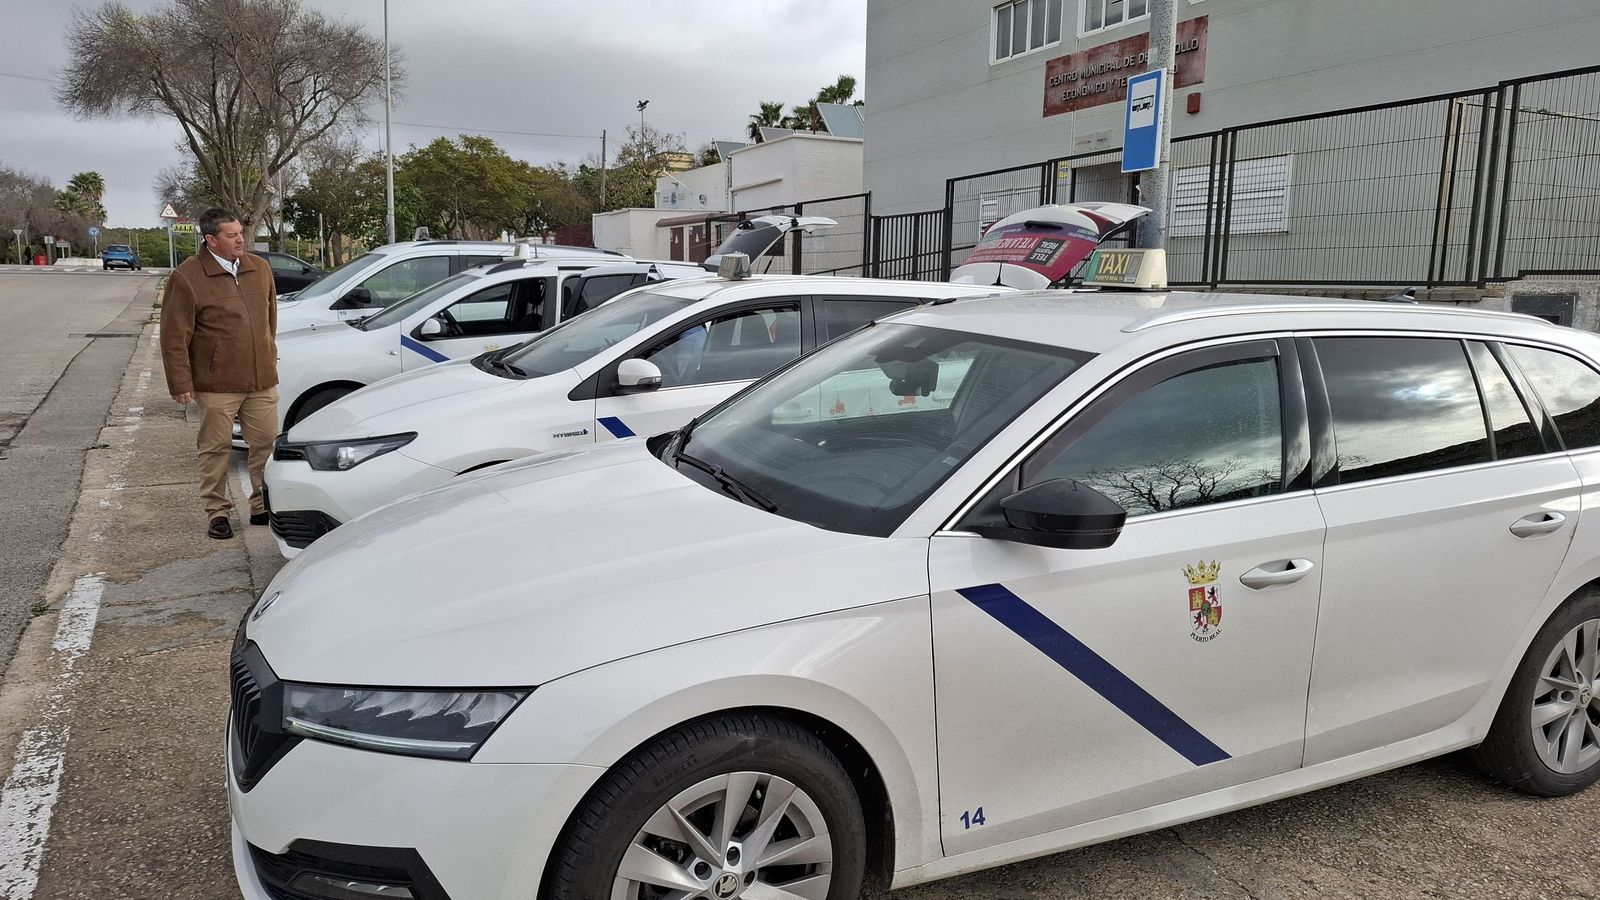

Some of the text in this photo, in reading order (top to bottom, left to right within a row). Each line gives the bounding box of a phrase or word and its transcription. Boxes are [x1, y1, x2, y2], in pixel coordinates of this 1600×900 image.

[1049, 71, 1078, 87] CENTRO
[1081, 59, 1122, 79] MUNICIPAL
[1123, 55, 1135, 68] DE
[1062, 81, 1107, 101] ECONÓMICO
[1029, 252, 1049, 261] TELE
[1098, 253, 1130, 274] TAXI
[1190, 631, 1209, 642] PUERTO
[960, 806, 986, 830] 14
